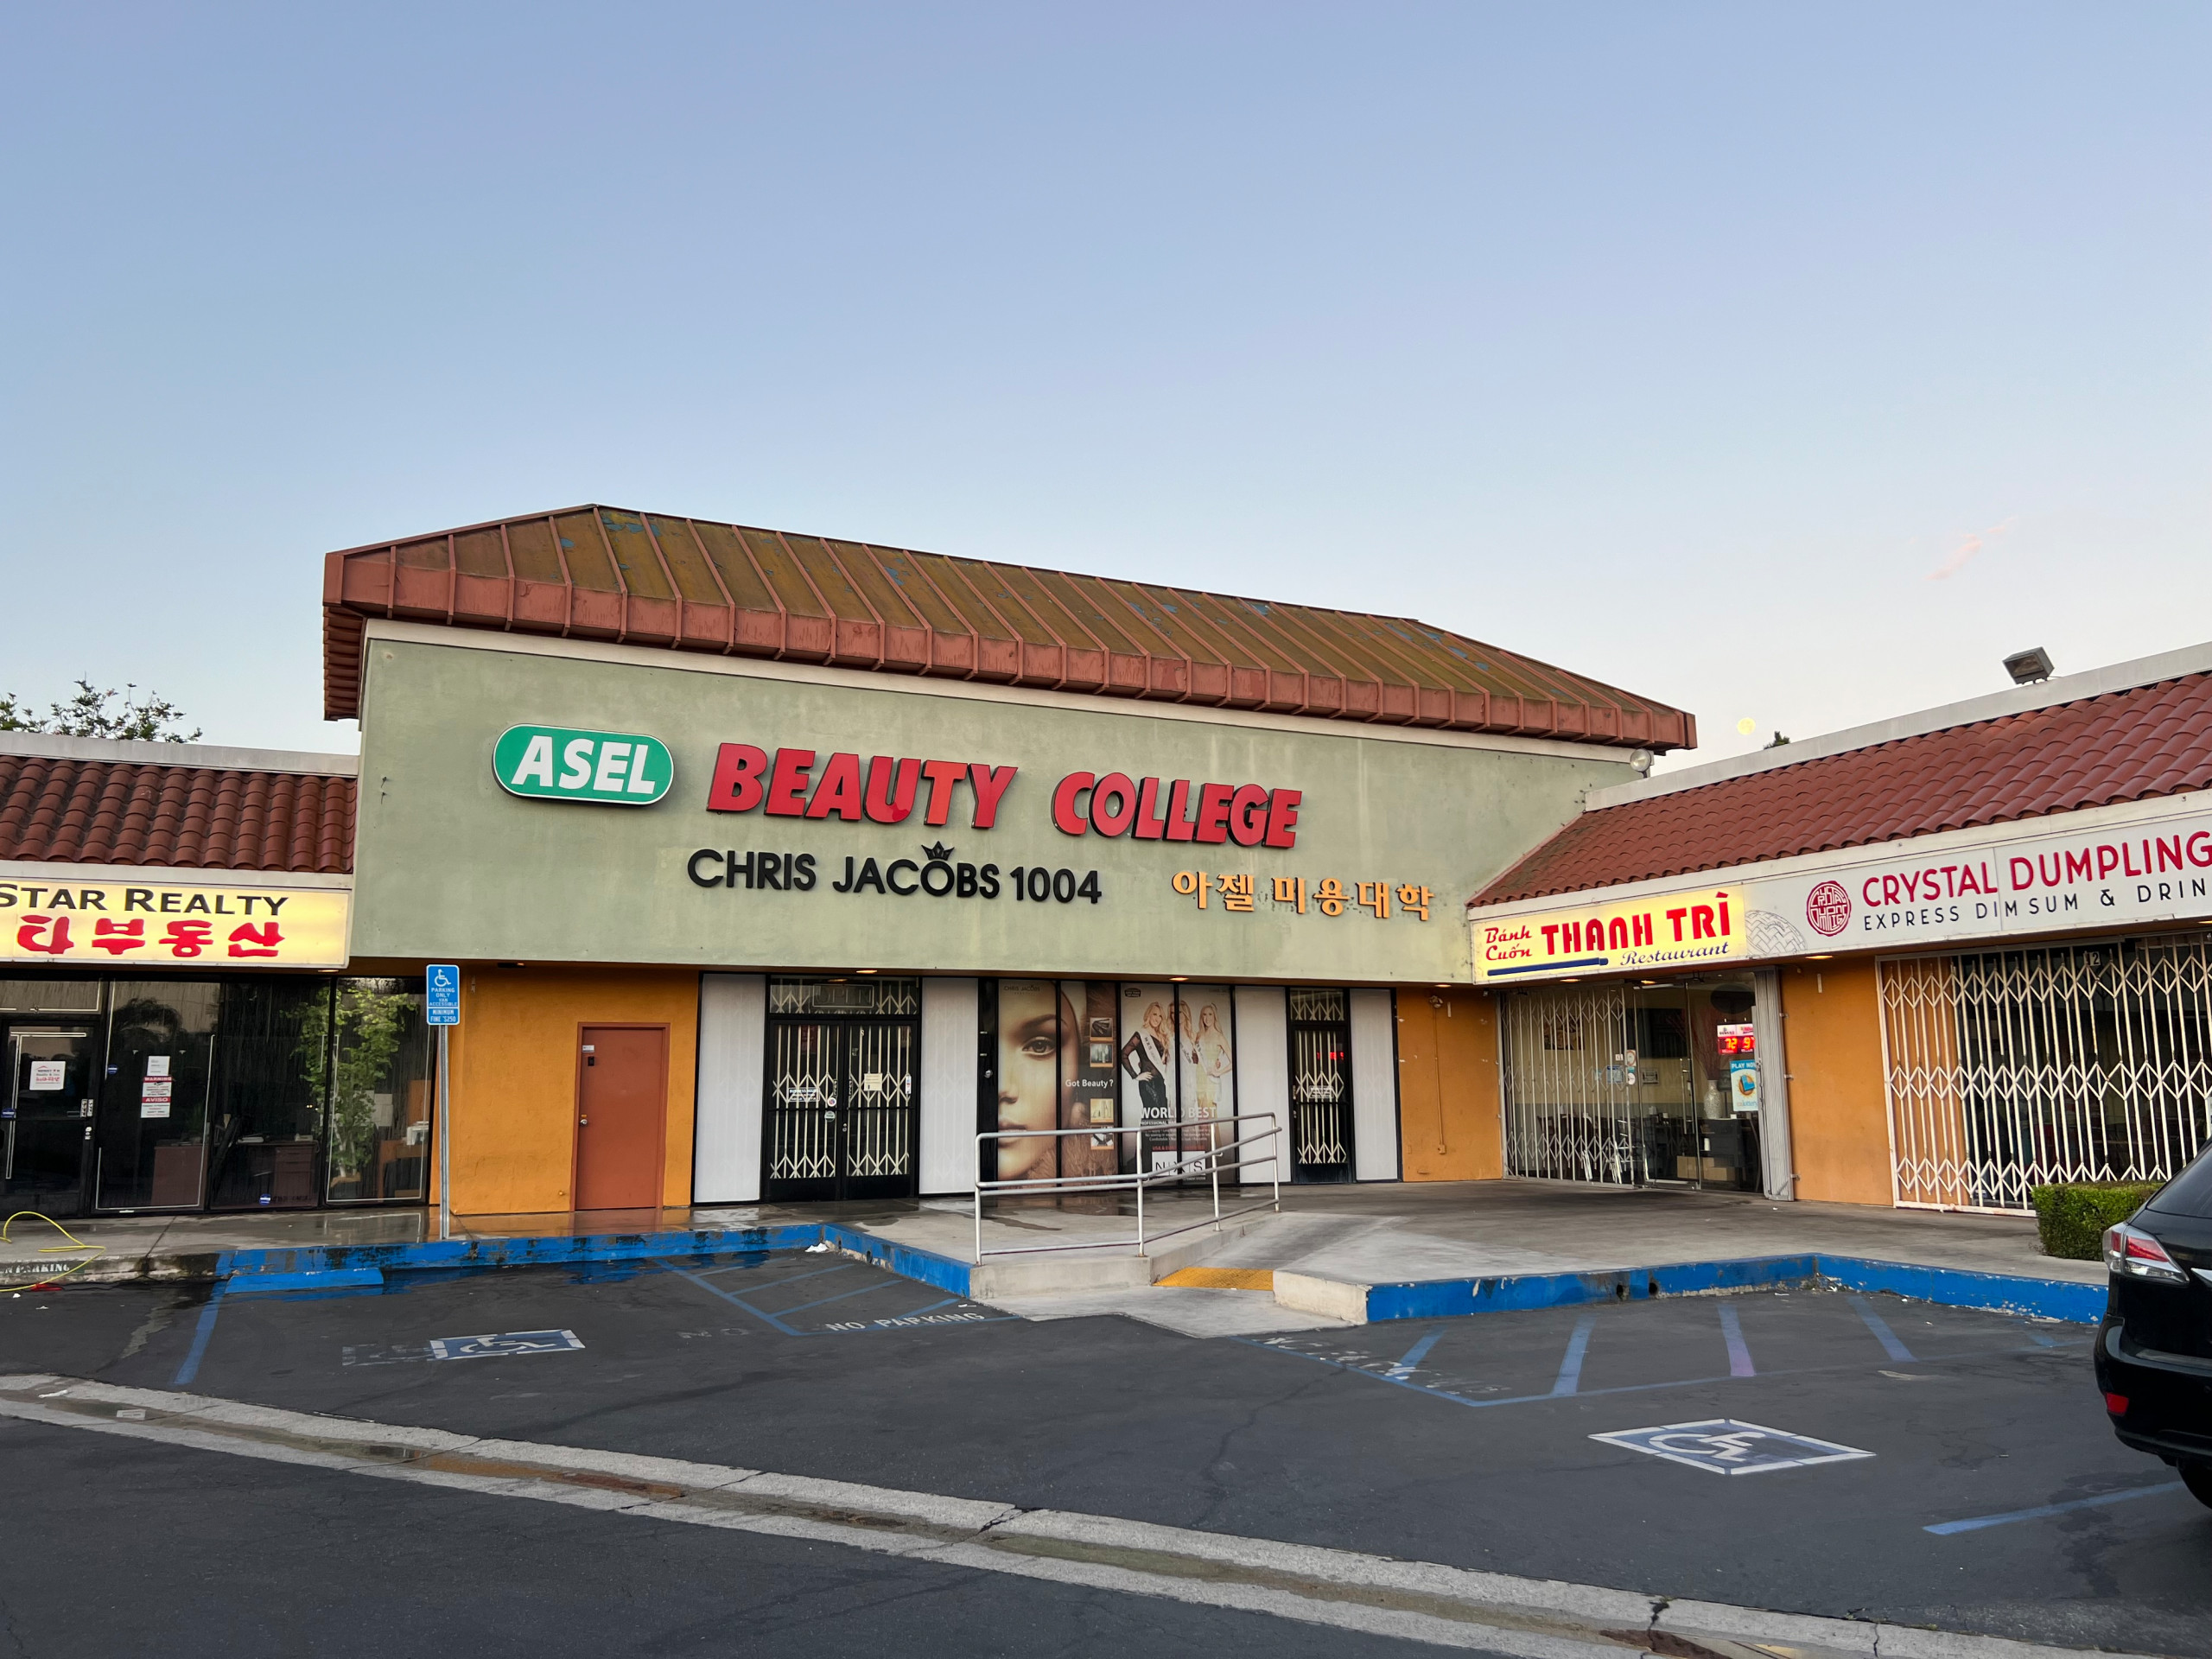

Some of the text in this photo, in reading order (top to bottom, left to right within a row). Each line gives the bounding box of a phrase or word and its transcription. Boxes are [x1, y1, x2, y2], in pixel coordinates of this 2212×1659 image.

[511, 735, 658, 795] ASEL
[706, 742, 1303, 849] BEAUTY COLLEGE
[687, 849, 1102, 905] CHRIS JACOBS 1004
[1862, 830, 2212, 907] CRYSTAL DUMPLING
[124, 888, 289, 916] REALTY
[1172, 871, 1435, 921] 아젤 미용대학
[1864, 905, 1959, 931] EXPRESS
[2100, 888, 2115, 907] &
[1484, 925, 1532, 944] Bánh
[1541, 891, 1731, 956] THANH TRÌ
[1485, 943, 1532, 961] Cuốn
[1620, 941, 1731, 966] Restaurant
[1189, 1107, 1217, 1118] BEST
[825, 1313, 985, 1332] NO PARKING
